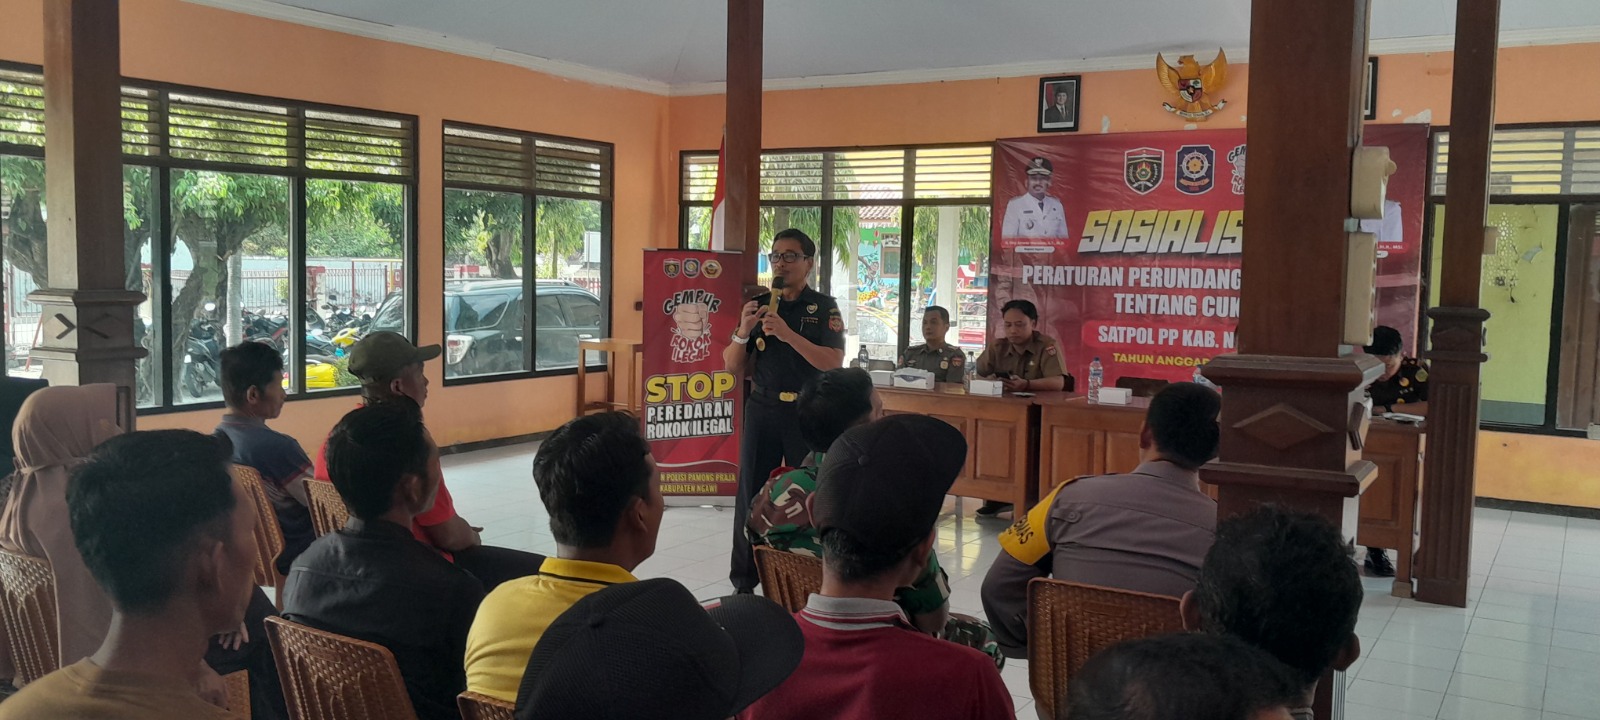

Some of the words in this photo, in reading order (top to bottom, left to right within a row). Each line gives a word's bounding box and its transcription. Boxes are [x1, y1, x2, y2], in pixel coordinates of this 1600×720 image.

[1022, 265, 1123, 287] PERATURAN
[1128, 267, 1241, 289] PERUNDANG
[663, 289, 721, 315] GEMPUR
[1114, 293, 1197, 316] TENTANG
[671, 333, 711, 351] ROKOK
[1098, 325, 1154, 345] SATPOL
[1158, 328, 1178, 346] PP
[1182, 329, 1219, 348] KAB.
[672, 345, 709, 362] ILEGAL
[1113, 353, 1154, 365] TAHUN
[645, 371, 735, 403] STOP
[647, 400, 733, 422] PEREDARAN
[646, 420, 690, 439] ROKOK
[692, 417, 733, 436] ILEGAL
[667, 472, 687, 482] POLISI
[688, 472, 714, 482] PAMONG
[715, 472, 736, 482] PRAJA
[660, 484, 695, 493] KABUPATEN
[696, 484, 717, 493] NGAWI
